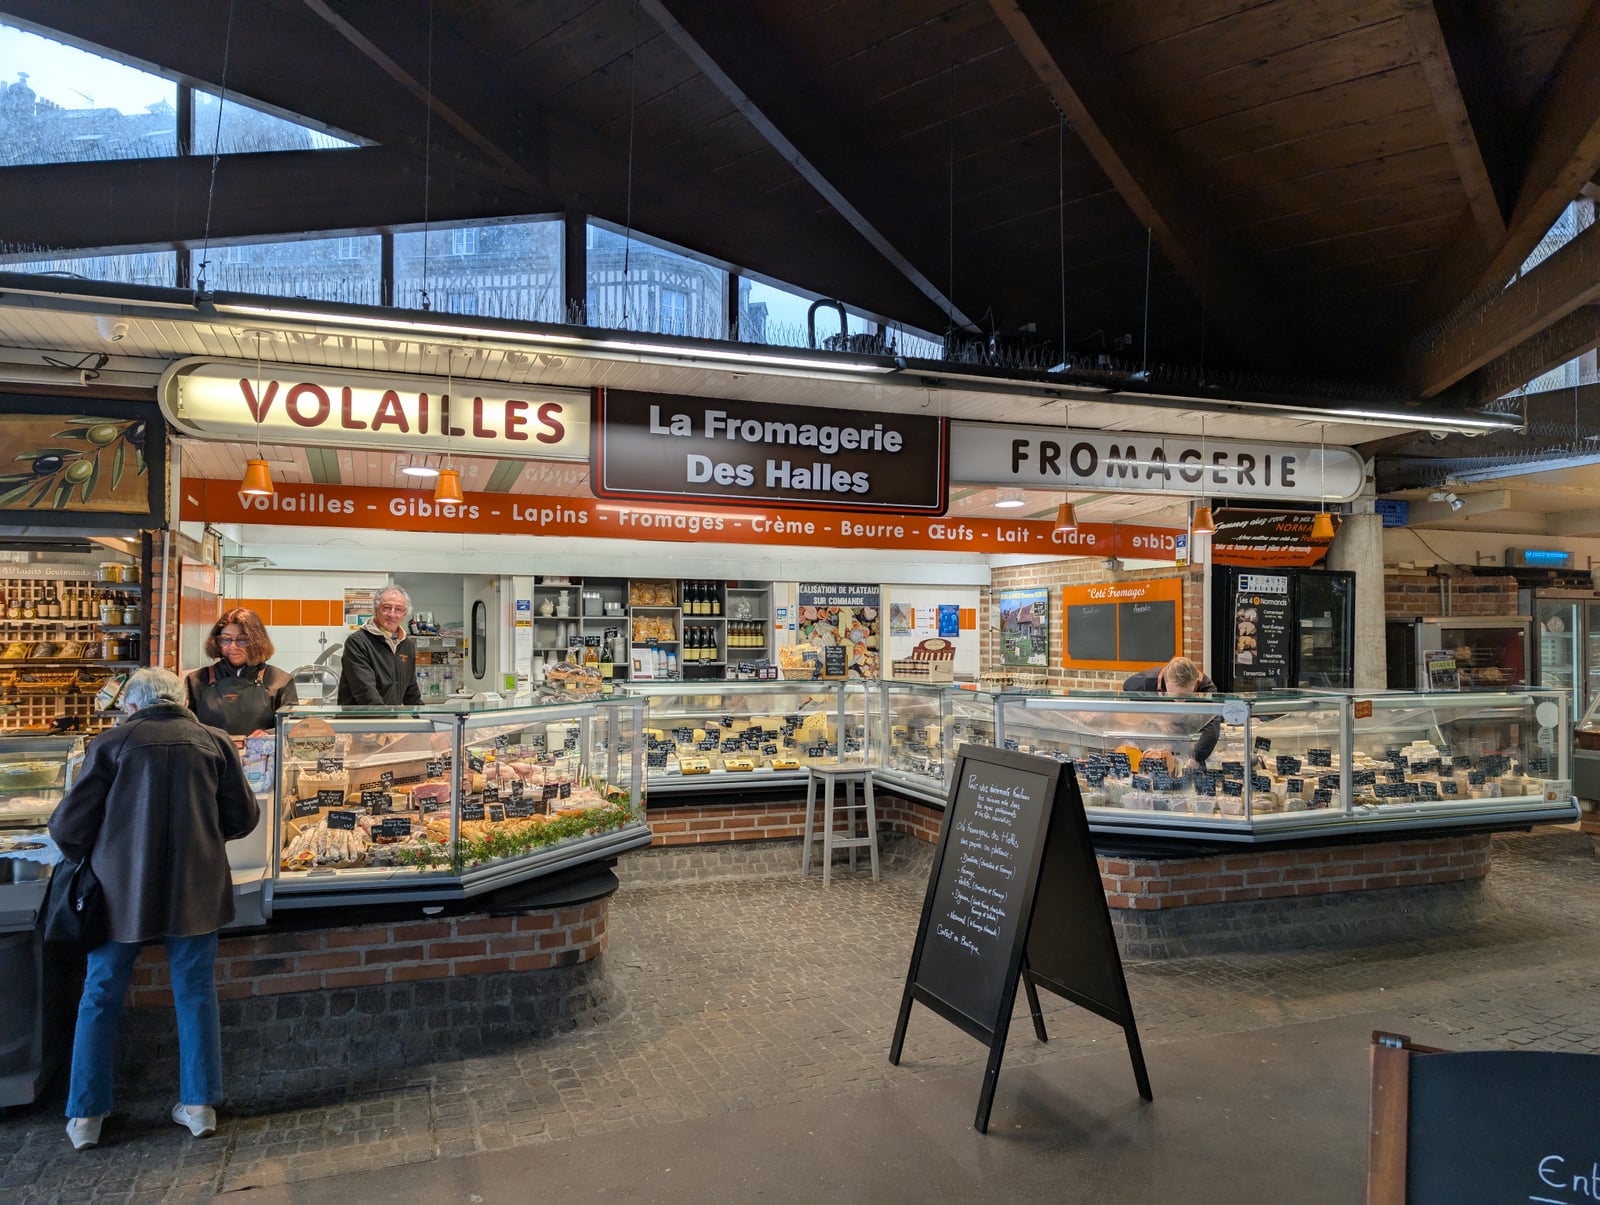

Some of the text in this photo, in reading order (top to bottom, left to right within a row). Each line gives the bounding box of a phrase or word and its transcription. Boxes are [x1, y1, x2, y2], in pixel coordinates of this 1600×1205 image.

[239, 377, 566, 444] VOLAILLES
[649, 404, 903, 454] La Fromagerie
[686, 453, 870, 493] Des Halles
[1011, 438, 1296, 488] FROMAGERIE
[238, 491, 354, 514] Volailles
[389, 497, 479, 519] Gibiers
[512, 504, 588, 527] Lapins
[618, 509, 725, 533] Fromages
[751, 515, 815, 536] Crème
[841, 520, 905, 539] Beurre
[928, 523, 974, 541] Œufs
[997, 526, 1029, 543] Lait
[1051, 529, 1096, 546] Cidre
[813, 597, 864, 605] SUR COMMANDE
[838, 586, 847, 594] DE
[1260, 598, 1287, 606] Normands
